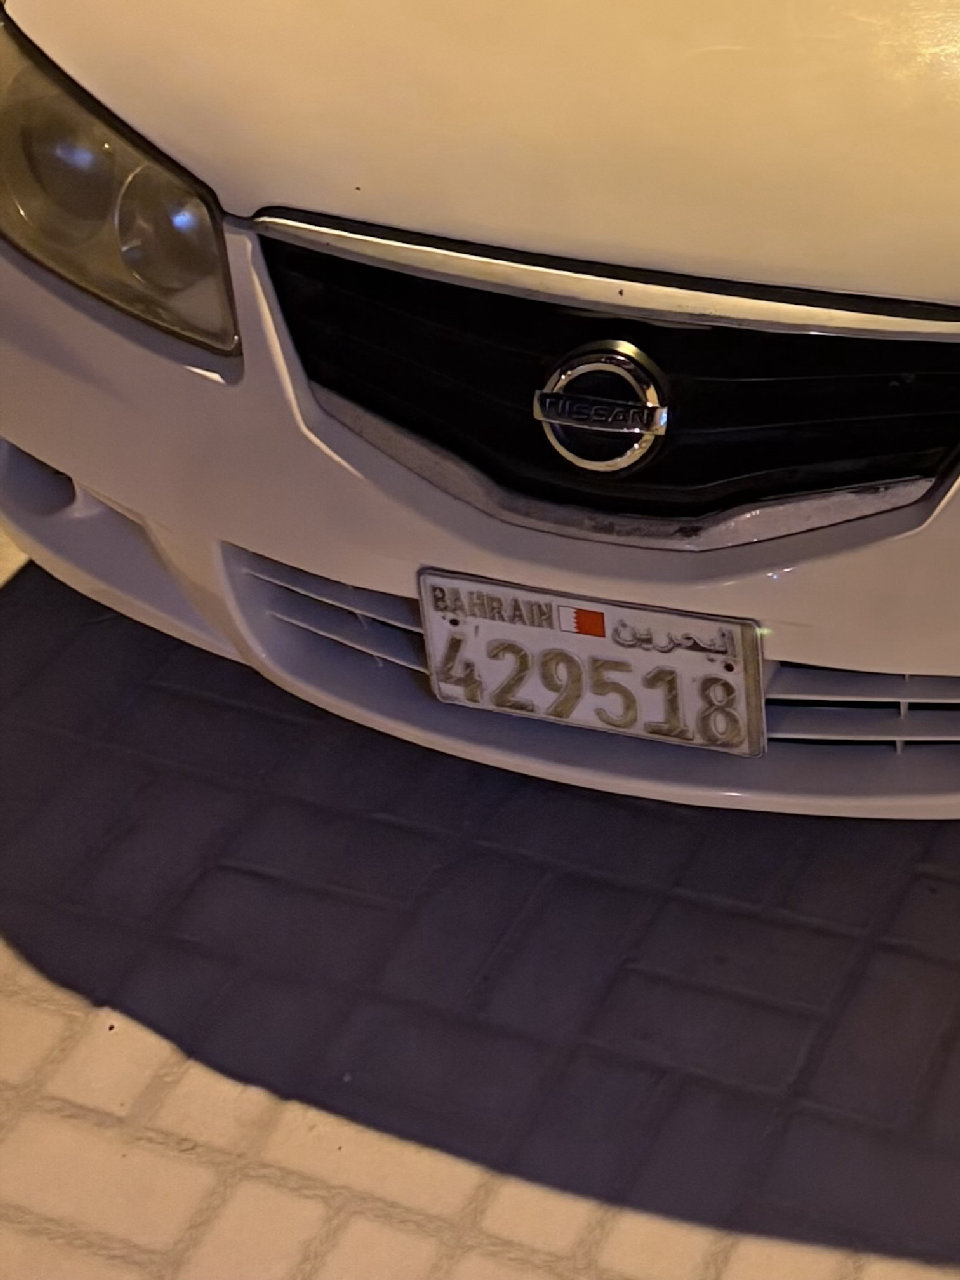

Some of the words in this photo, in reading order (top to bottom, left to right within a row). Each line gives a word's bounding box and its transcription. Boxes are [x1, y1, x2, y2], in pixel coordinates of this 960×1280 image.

[544, 397, 649, 425] NISSAN
[431, 585, 555, 630] BAHRAIN
[611, 619, 738, 663] البحرين
[435, 631, 747, 748] 429518
